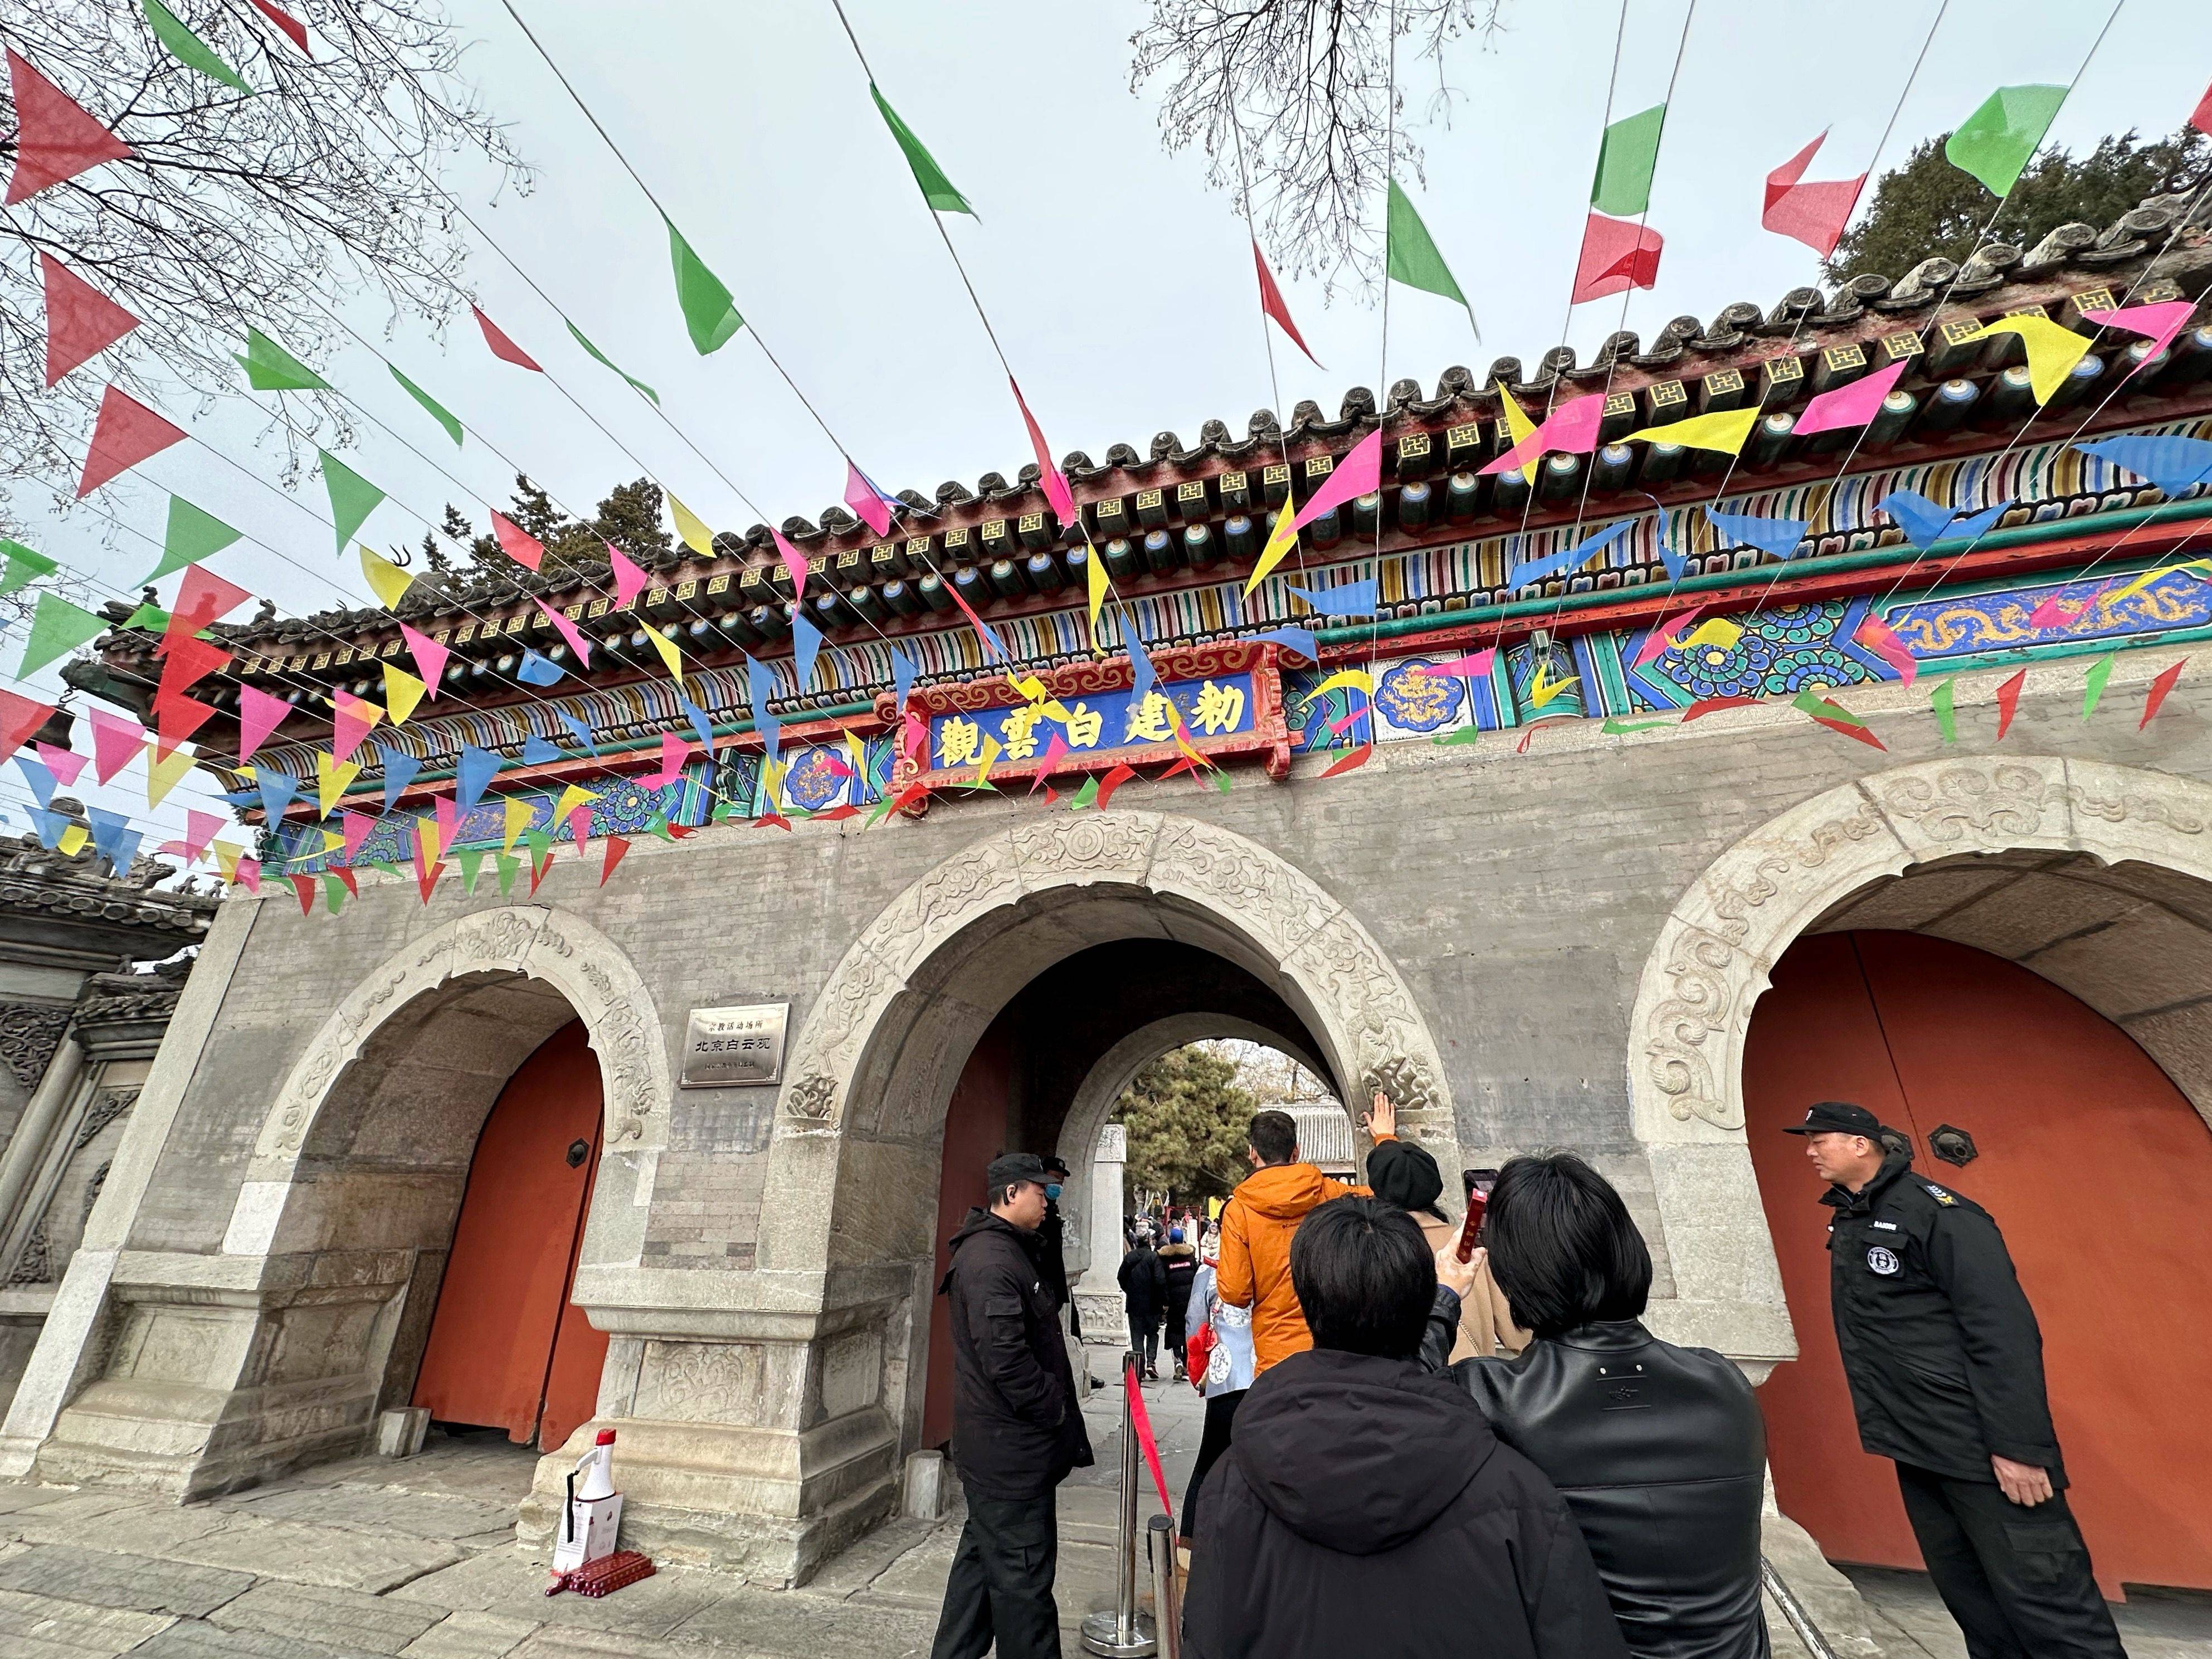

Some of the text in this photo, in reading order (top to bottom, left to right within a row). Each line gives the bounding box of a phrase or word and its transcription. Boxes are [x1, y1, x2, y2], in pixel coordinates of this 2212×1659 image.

[708, 1020, 763, 1032] 宗教活动场所
[695, 1038, 771, 1052] 北京白云观
